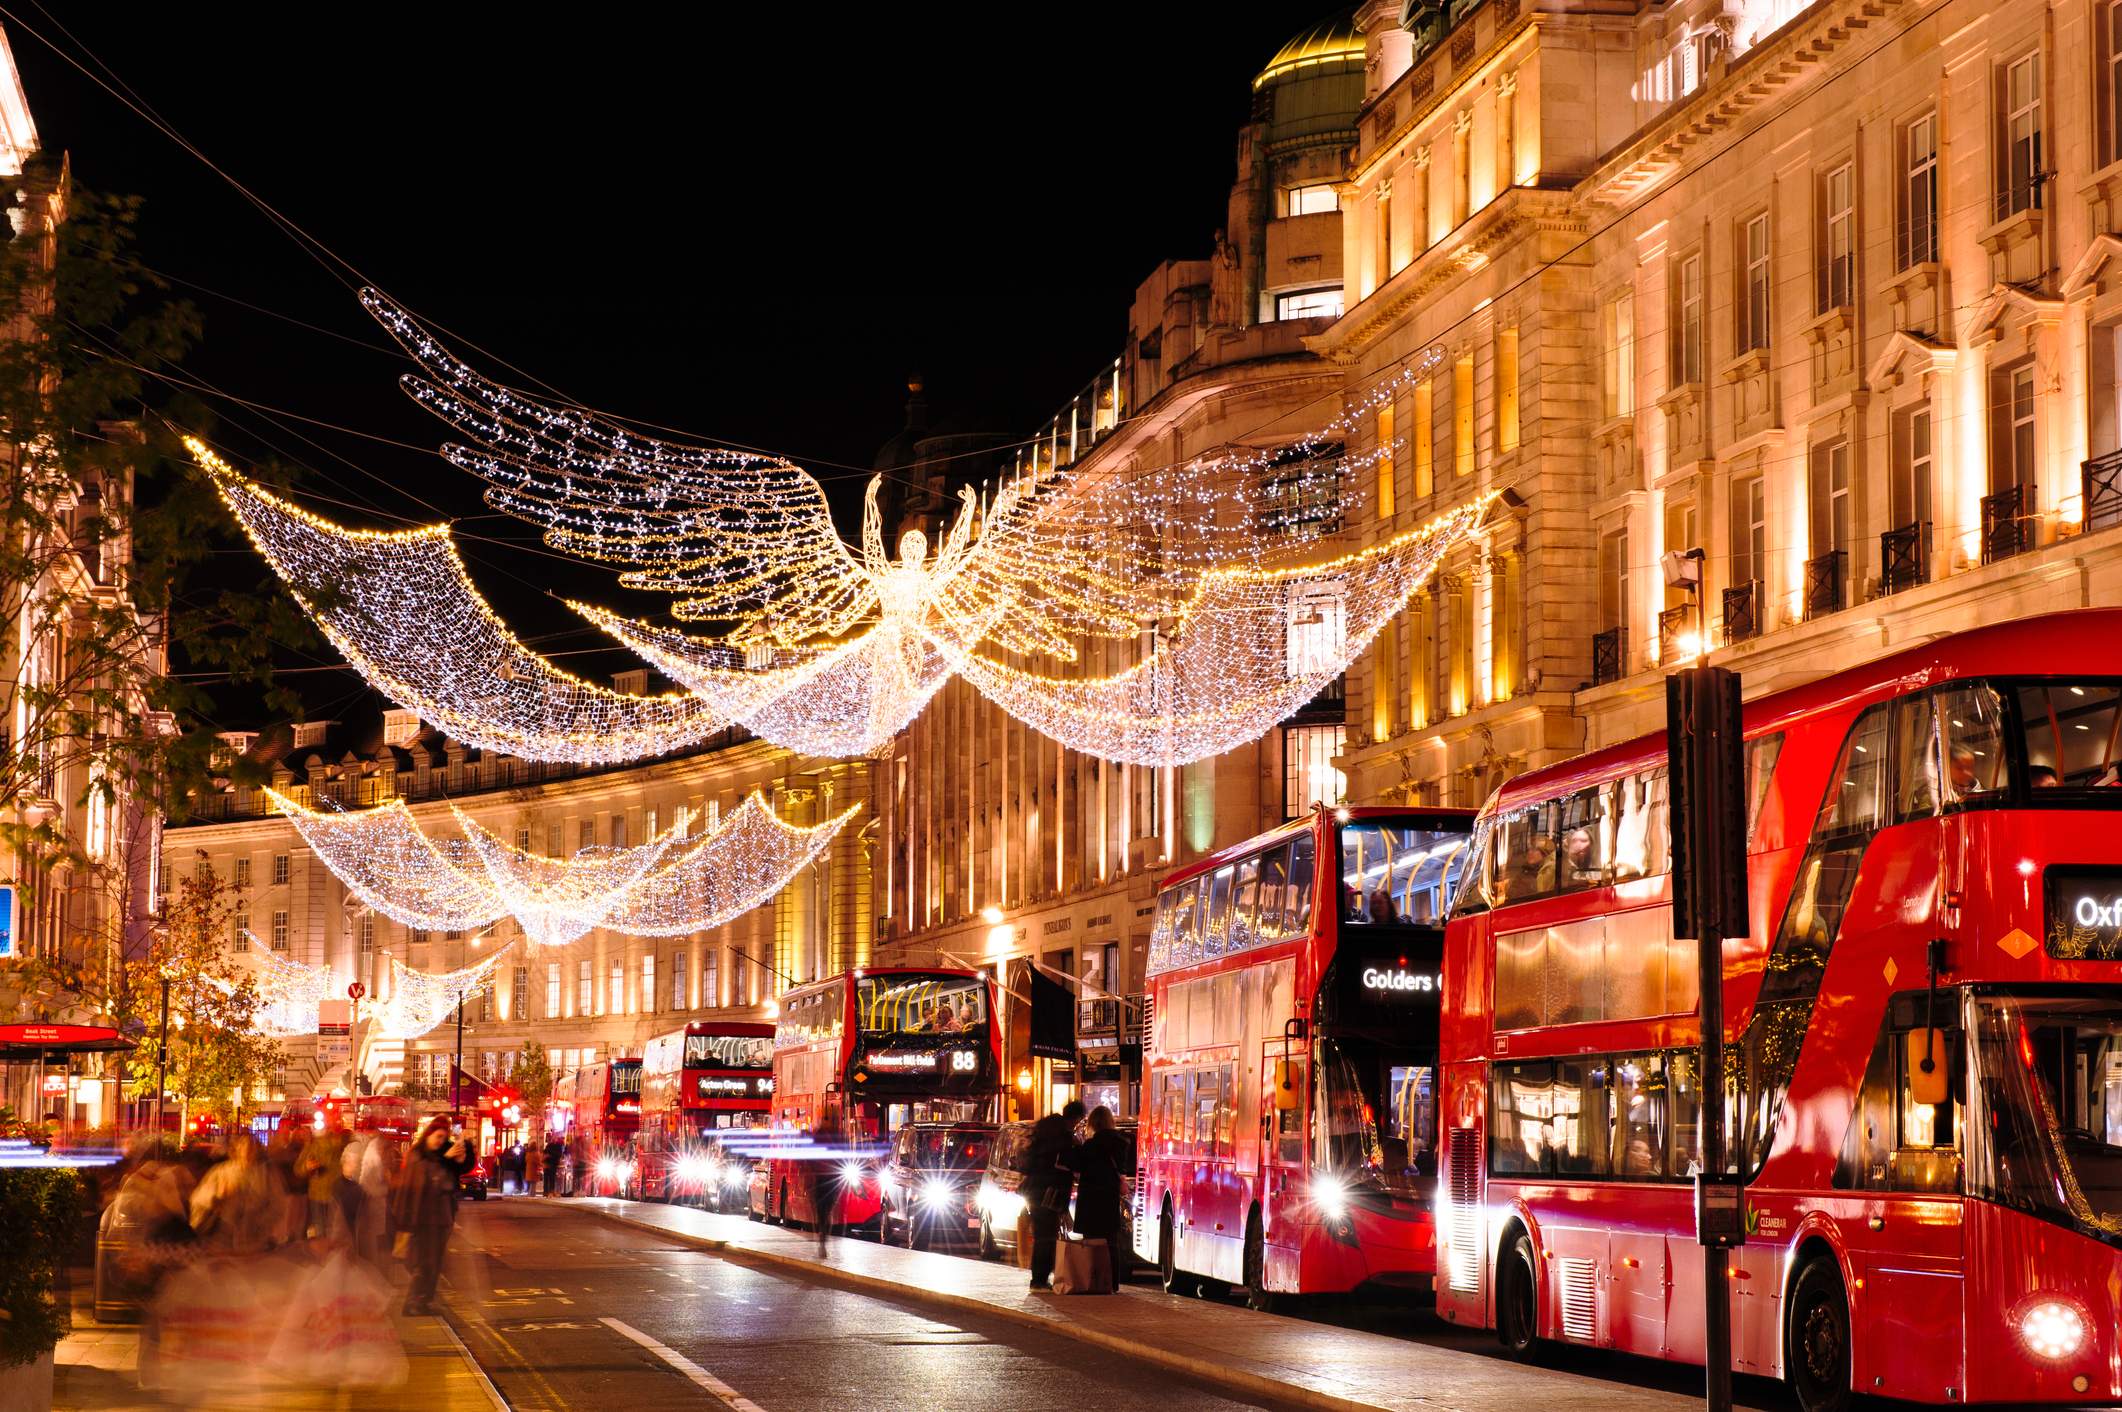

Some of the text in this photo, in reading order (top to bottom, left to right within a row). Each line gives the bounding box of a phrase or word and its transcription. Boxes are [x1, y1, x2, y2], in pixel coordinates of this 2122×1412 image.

[1362, 968, 1433, 992] Golders
[952, 1051, 975, 1070] 88
[700, 1079, 747, 1090] Acton Green
[757, 1078, 774, 1093] 94
[1760, 1217, 1780, 1228] CLEANER
